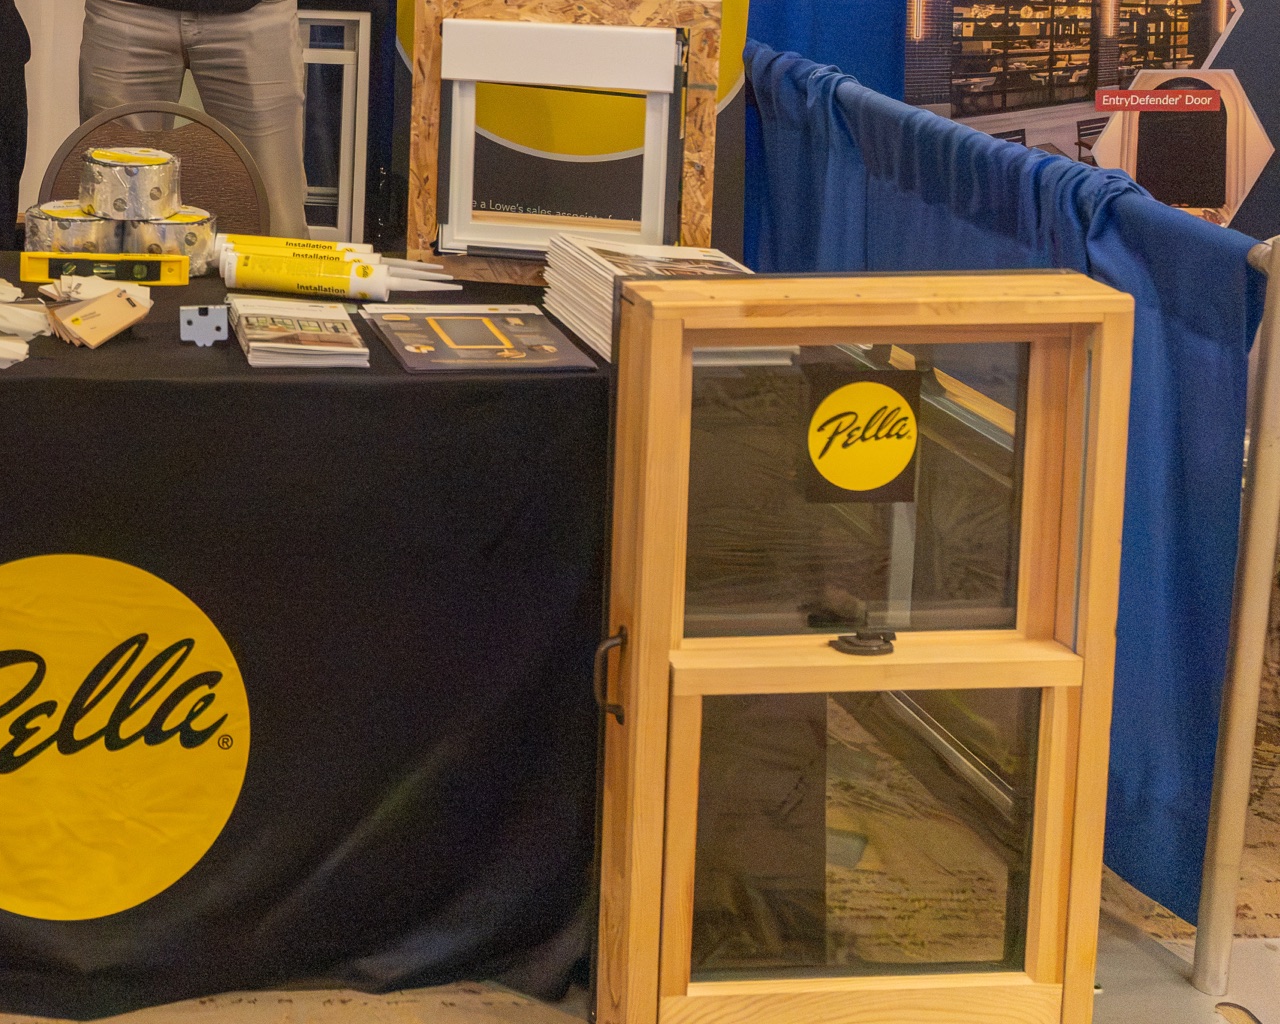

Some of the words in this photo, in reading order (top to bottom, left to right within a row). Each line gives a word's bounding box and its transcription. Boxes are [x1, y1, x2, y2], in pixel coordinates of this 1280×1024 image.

[1184, 94, 1213, 107] Door
[480, 201, 487, 209] a
[489, 199, 524, 213] Lowe's
[526, 205, 552, 216] sales
[285, 241, 333, 250] Installation
[296, 283, 346, 294] Installation
[817, 405, 911, 460] Pella
